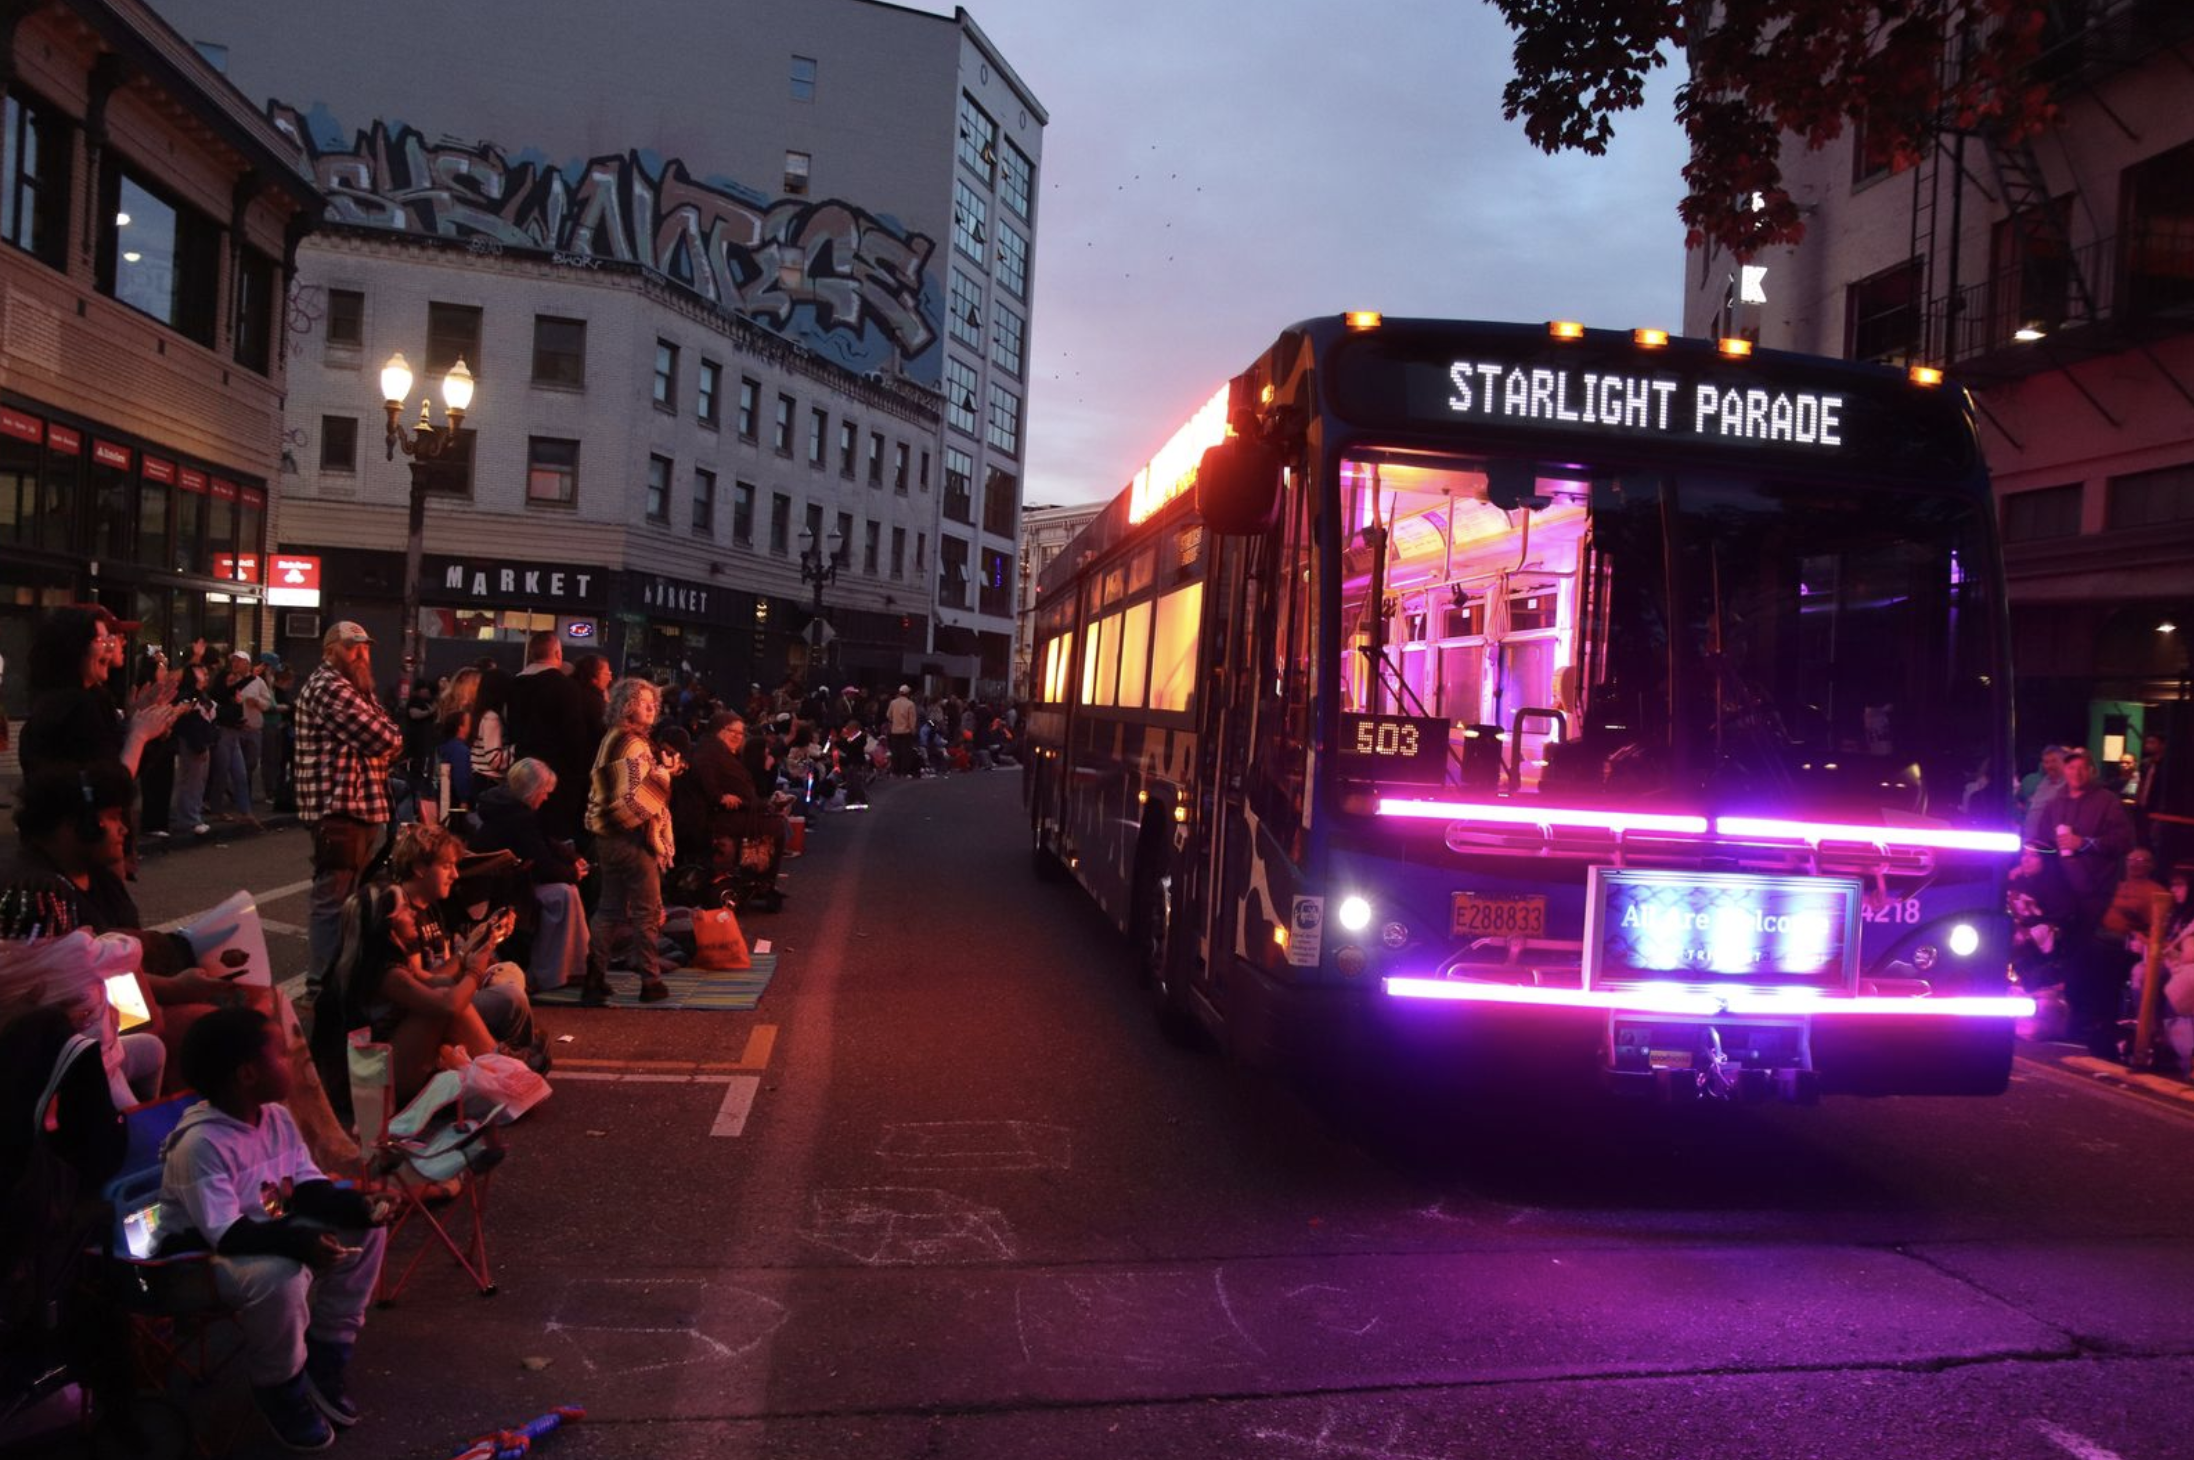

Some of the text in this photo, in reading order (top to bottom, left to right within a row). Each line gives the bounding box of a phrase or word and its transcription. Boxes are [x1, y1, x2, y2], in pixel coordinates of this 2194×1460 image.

[1449, 361, 1843, 446] STARLIGHT PARADE
[445, 565, 591, 598] MARKET
[1357, 721, 1419, 756] 503
[1456, 904, 1541, 932] E288833
[1861, 898, 1920, 924] 4218
